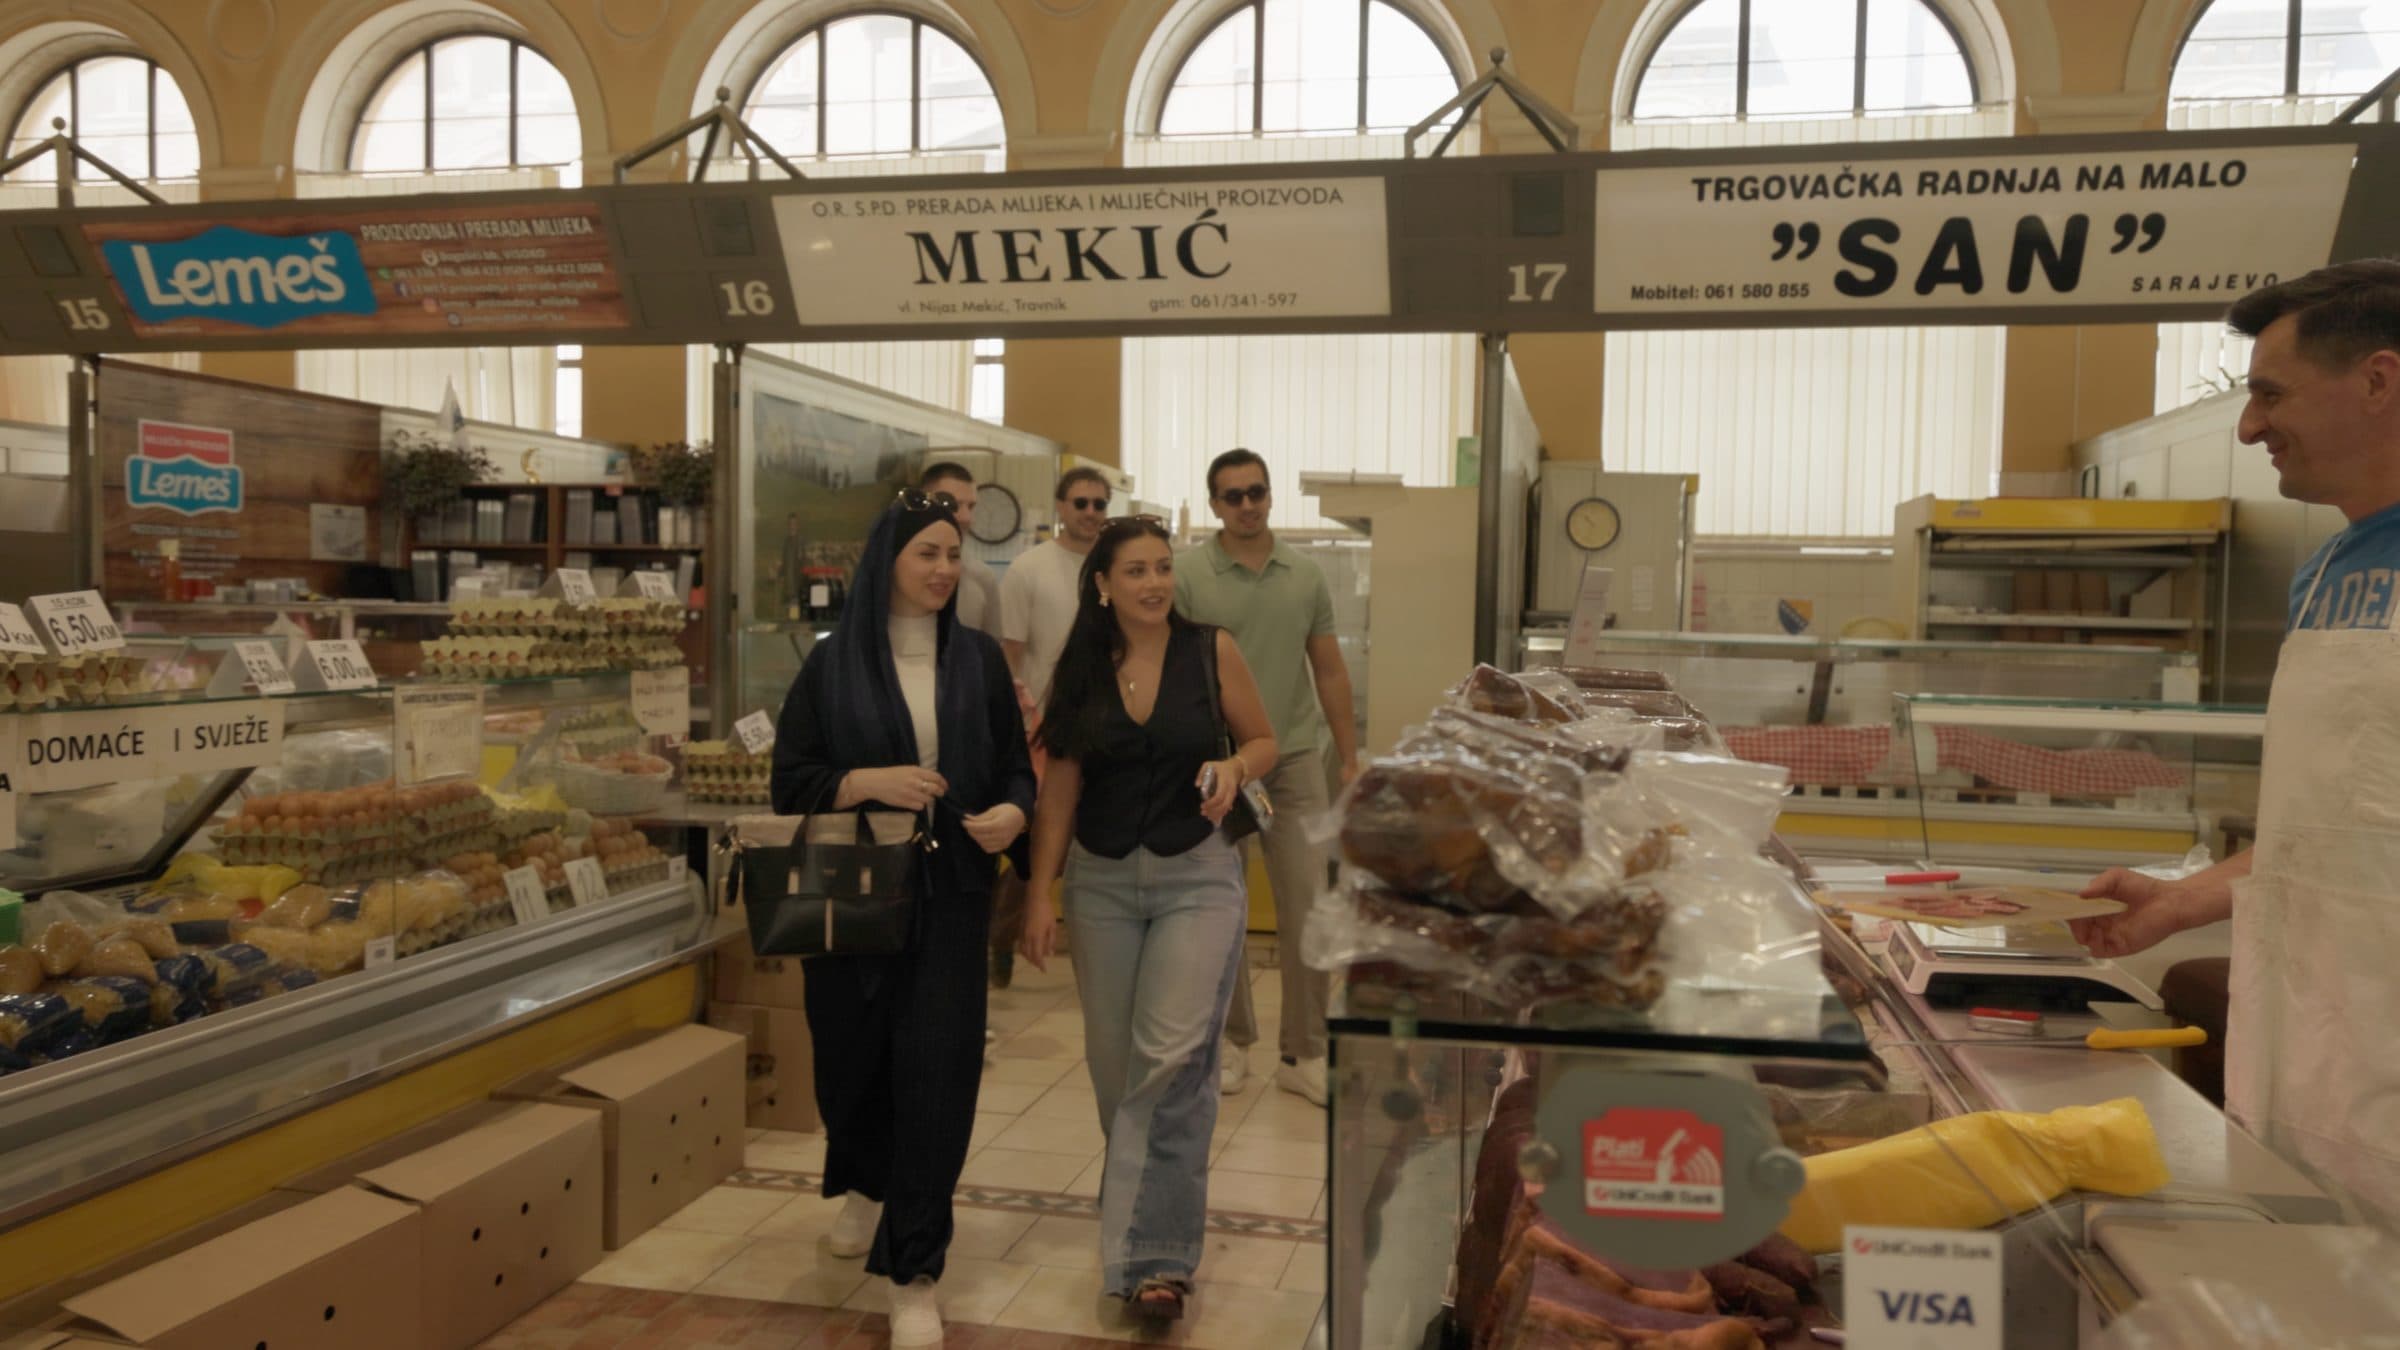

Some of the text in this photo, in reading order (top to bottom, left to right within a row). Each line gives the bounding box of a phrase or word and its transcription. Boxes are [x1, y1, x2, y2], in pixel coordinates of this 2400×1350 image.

[1691, 160, 2247, 203] TRGOVAČKA RADNJA NA MALO
[907, 198, 995, 215] PRERADA
[1001, 194, 1083, 213] MLIJEKA
[1088, 192, 1095, 210] I
[1100, 188, 1209, 210] MLIJEČNIH
[1217, 186, 1343, 206] PROIZVODA
[360, 221, 458, 241] PROIZVODNJA
[464, 219, 531, 238] PRERADA
[531, 216, 594, 236] MLIJEKA
[905, 208, 1231, 284] MEKIĆ
[131, 237, 346, 306] Lemeš
[1508, 263, 1567, 302] 17
[720, 280, 774, 316] 16
[1015, 298, 1067, 312] Travnik
[1149, 293, 1297, 312] gsm: 061/341-597
[1631, 283, 1810, 299] Mobitel: 061 580 855
[60, 298, 110, 330] 15
[140, 462, 232, 502] Lemeš
[48, 613, 119, 650] 6,50 KM
[318, 656, 357, 683] 6,00
[28, 725, 145, 766] DOMAĆE
[194, 714, 270, 750] SVJEŽE
[1592, 1135, 1646, 1160] Plati
[1873, 1239, 1945, 1258] UniCredit
[1874, 1289, 1976, 1326] VISA
